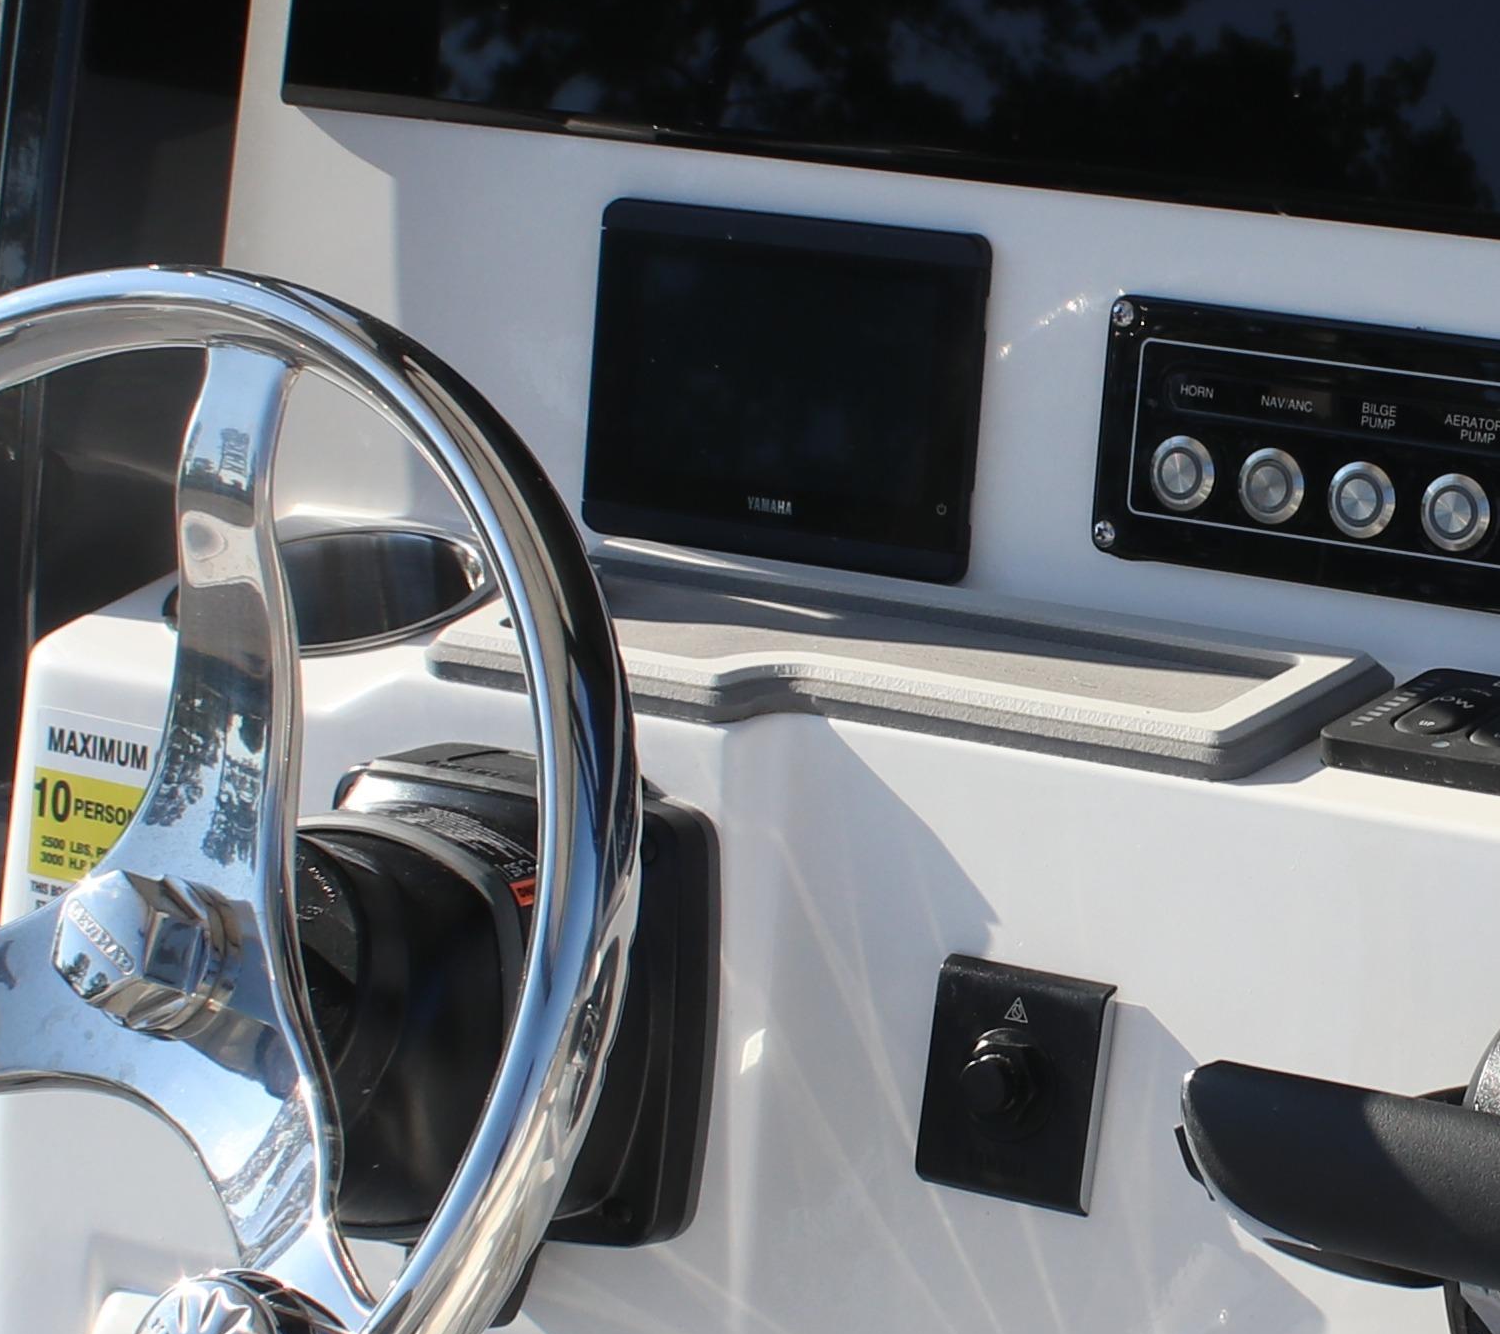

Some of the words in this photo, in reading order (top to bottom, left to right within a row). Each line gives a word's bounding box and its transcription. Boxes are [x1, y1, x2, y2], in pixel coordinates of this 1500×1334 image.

[1180, 383, 1214, 400] HORN
[1260, 394, 1313, 413] NAV/ANC
[1361, 401, 1397, 419] BILGE
[1360, 414, 1397, 431] PUMP
[1460, 427, 1497, 445] PUMP
[747, 495, 793, 516] YAMAHA
[1418, 719, 1436, 728] UP
[47, 725, 149, 771] MAXIMUM
[33, 776, 71, 823] 10
[41, 835, 66, 851] 2500
[30, 880, 49, 895] THIS
